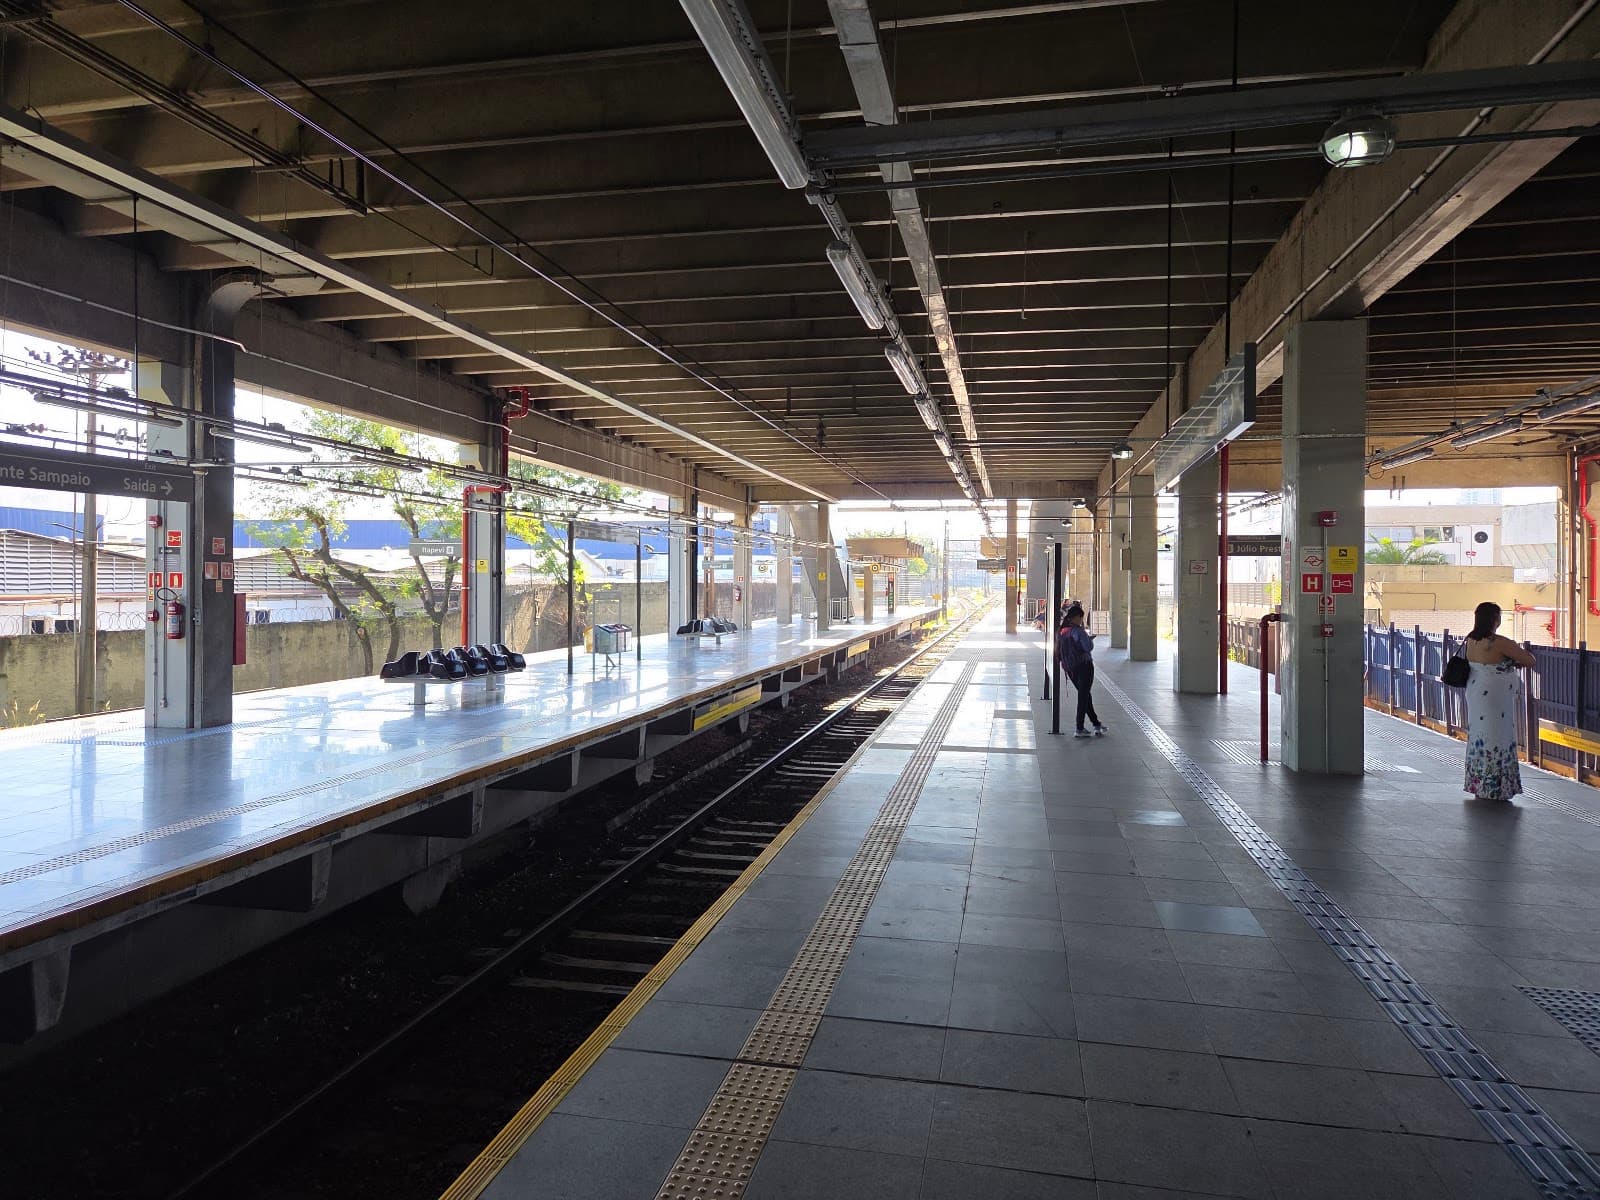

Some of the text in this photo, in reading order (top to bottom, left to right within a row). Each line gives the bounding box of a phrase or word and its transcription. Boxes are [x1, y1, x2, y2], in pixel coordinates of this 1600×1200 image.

[29, 466, 91, 487] Sampaio
[123, 477, 157, 492] Saída
[422, 546, 445, 554] Itapevi
[1236, 543, 1257, 553] Júlio
[1306, 576, 1318, 590] H
